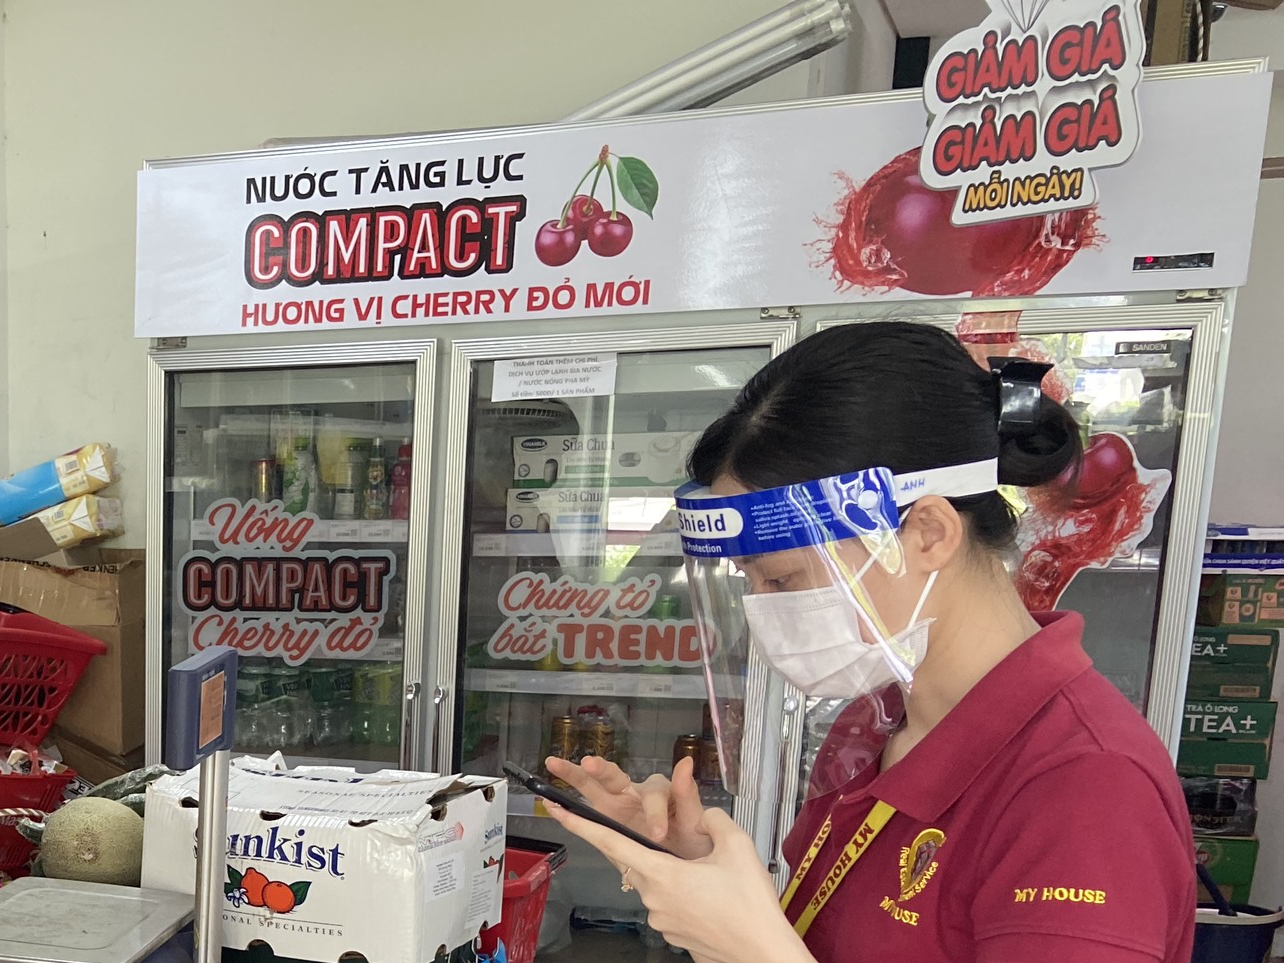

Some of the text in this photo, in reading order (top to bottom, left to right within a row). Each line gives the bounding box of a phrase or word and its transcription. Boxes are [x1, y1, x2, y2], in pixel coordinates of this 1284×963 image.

[936, 4, 1125, 104] GIẢM GIÁ
[932, 84, 1123, 177] GIẢM GIÁ
[246, 151, 526, 205] NƯỚC TĂNG LỰC
[963, 166, 1083, 214] MỖI NGÀY!
[245, 194, 527, 291] COMPACT
[241, 277, 652, 328] HƯƠNG VỊ CHERRY ĐỎ MỚI
[1132, 343, 1167, 351] SANDEN
[207, 502, 315, 551] Uống
[183, 555, 392, 613] COMPACT
[501, 576, 654, 618] Chứng tỏ
[191, 612, 381, 661] Cherry đỏ
[492, 620, 711, 663] bắt TREND
[1214, 705, 1239, 714] LONG
[852, 821, 875, 853] MY
[812, 851, 855, 911] HOUSE
[1015, 887, 1106, 904] MY HOUSE
[259, 919, 343, 937] SPECIALTIES
